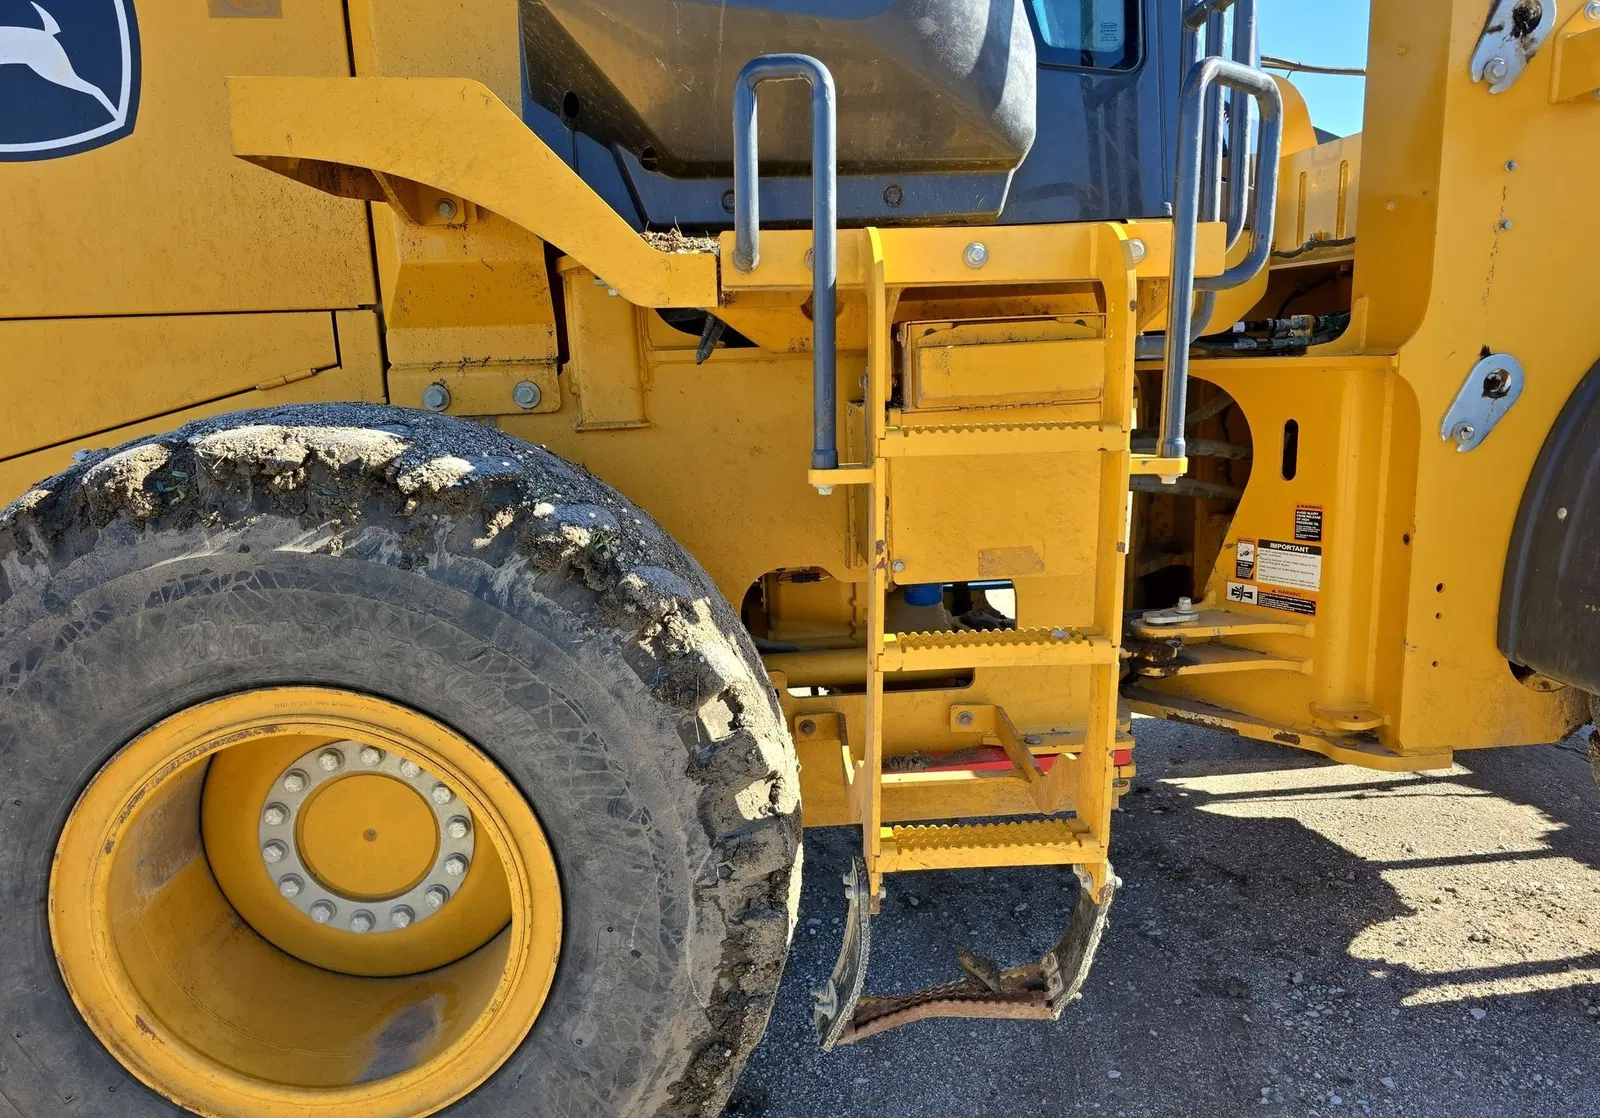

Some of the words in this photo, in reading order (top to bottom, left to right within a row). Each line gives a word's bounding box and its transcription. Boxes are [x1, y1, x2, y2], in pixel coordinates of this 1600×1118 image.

[1270, 543, 1309, 553] IMPORTANT
[1278, 589, 1302, 597] WARNING
[186, 618, 563, 753] BRIDGESTONE
